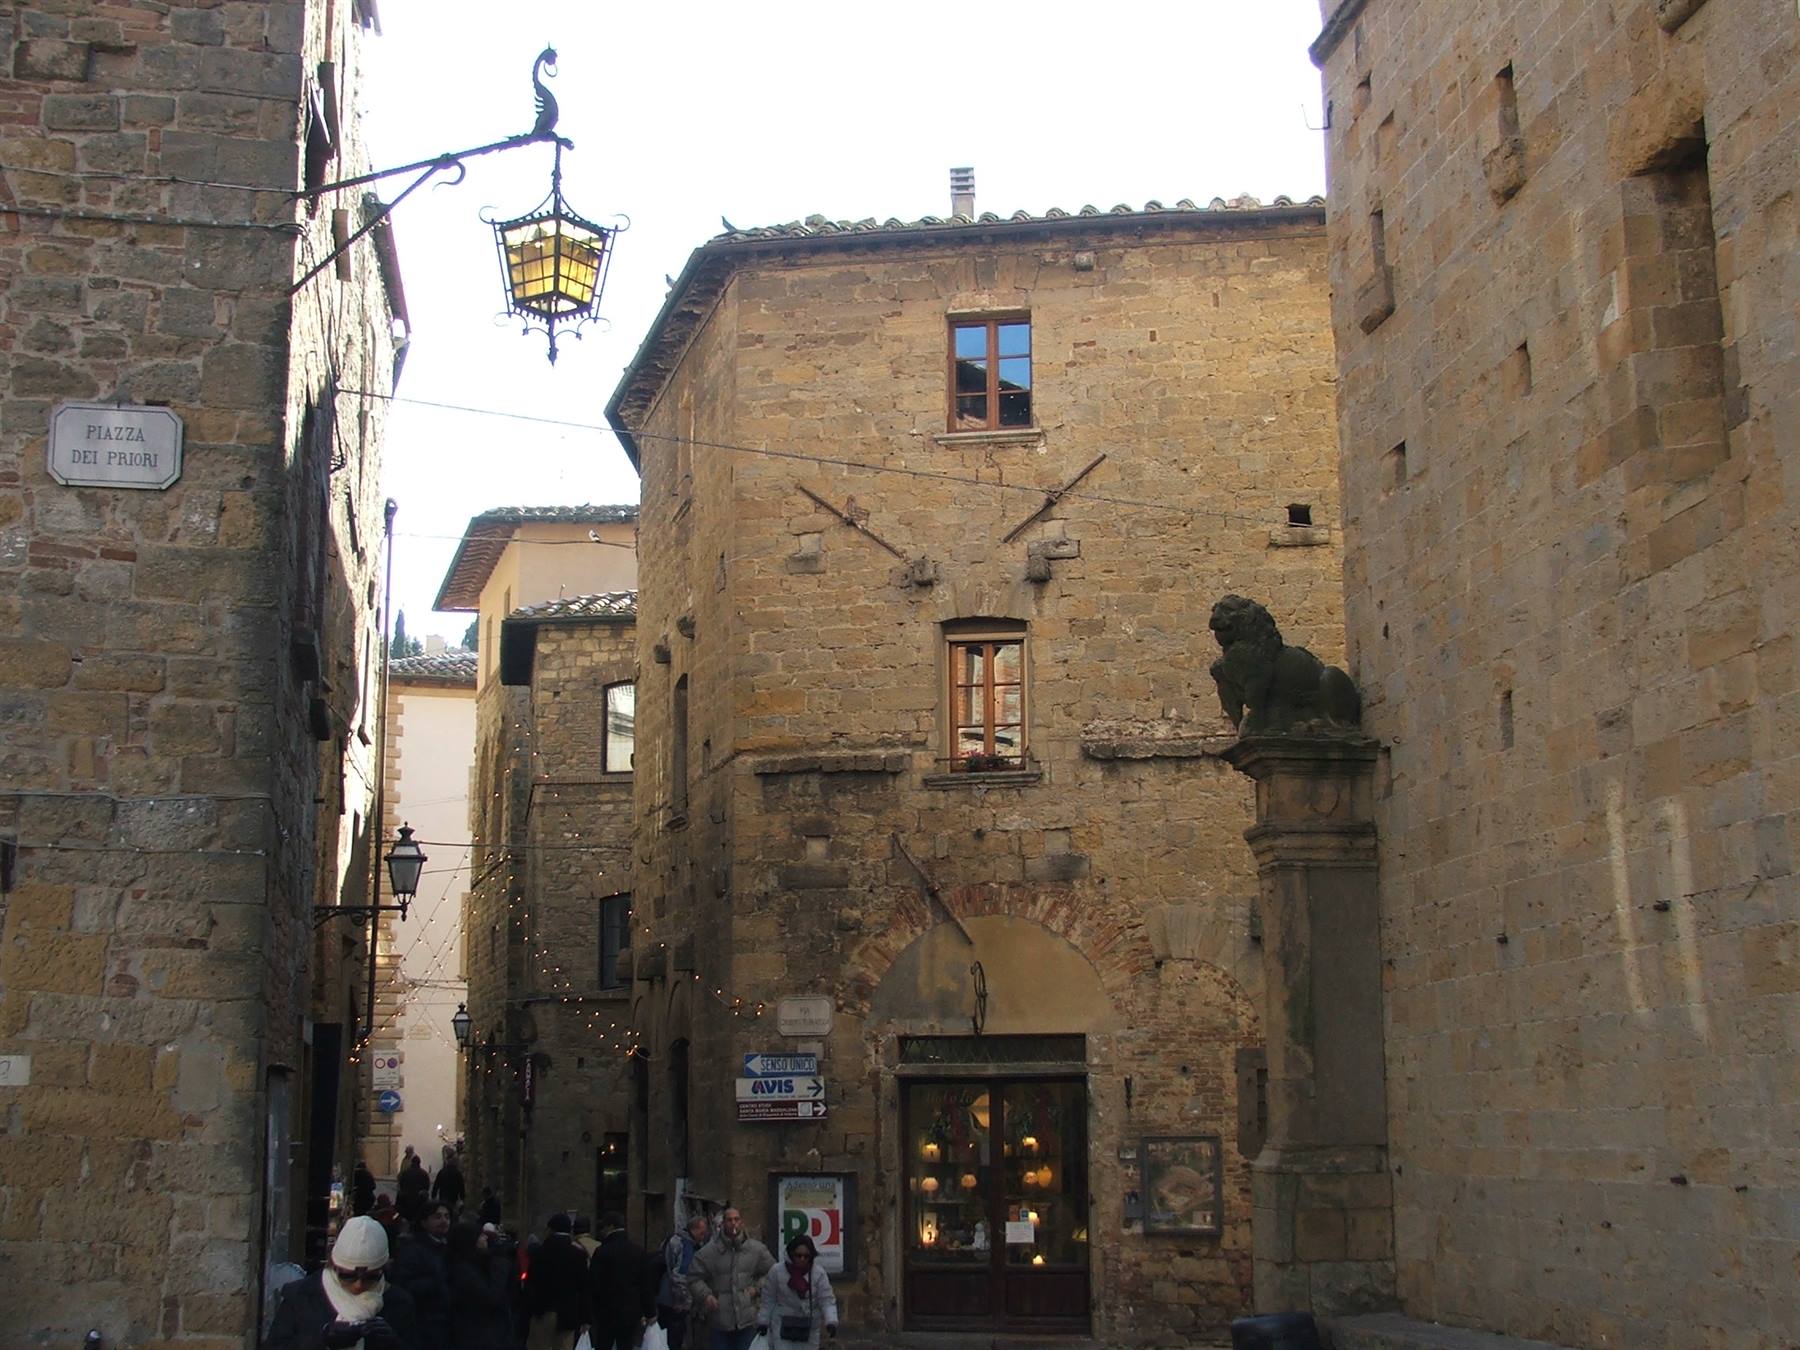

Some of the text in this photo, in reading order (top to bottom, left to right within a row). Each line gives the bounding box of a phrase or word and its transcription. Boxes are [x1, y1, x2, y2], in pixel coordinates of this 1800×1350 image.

[86, 425, 145, 442] PIAZZA
[72, 449, 158, 468] DEI PRIORI
[760, 1057, 815, 1071] SENSO UNICO
[751, 1079, 794, 1094] AVIS
